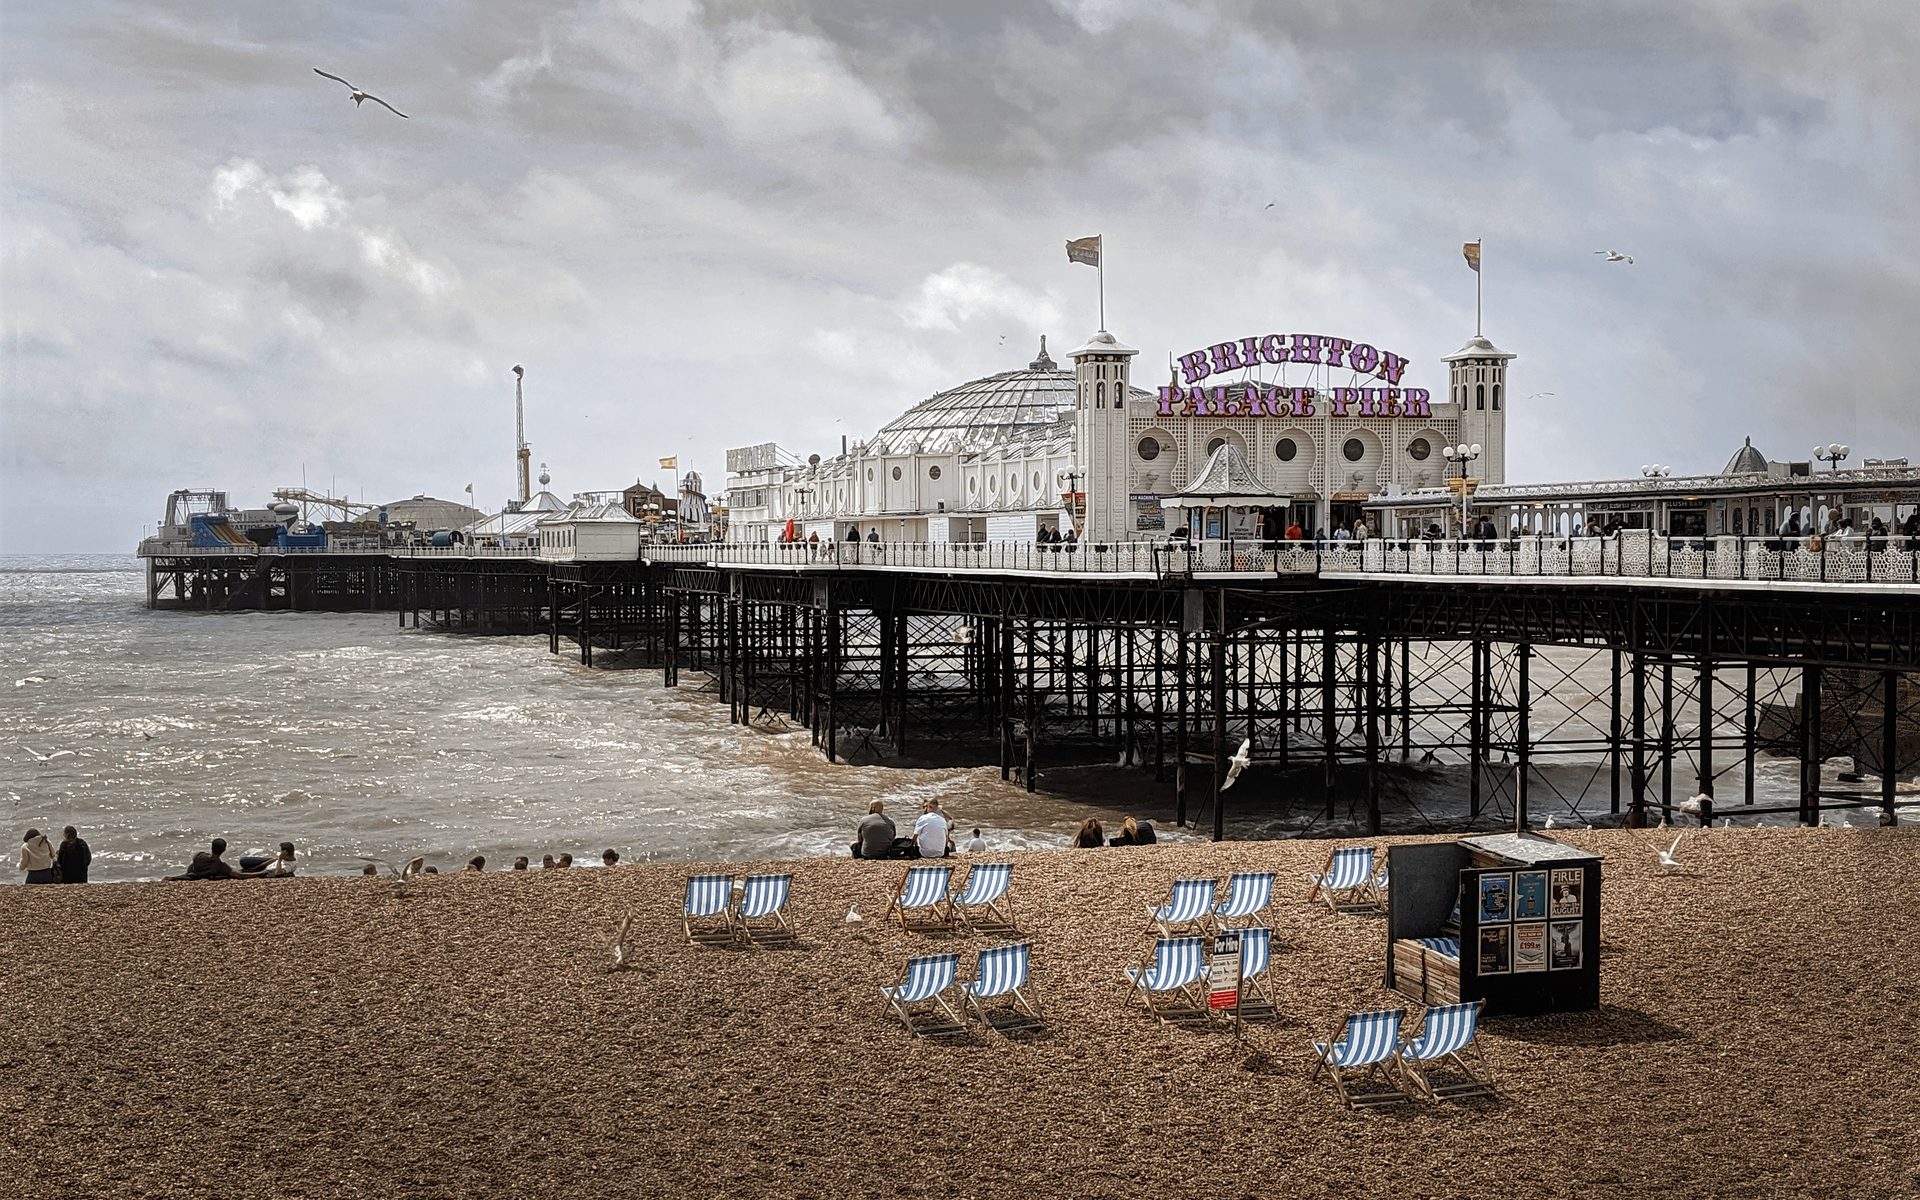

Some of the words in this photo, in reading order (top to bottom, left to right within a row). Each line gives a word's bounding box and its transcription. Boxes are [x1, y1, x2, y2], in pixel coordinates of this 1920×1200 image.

[1177, 334, 1409, 386] BRIGHTON
[1156, 386, 1317, 418] PALACE
[1331, 387, 1433, 419] PIER
[1552, 871, 1581, 882] FIRLE
[1214, 938, 1225, 952] For
[1225, 936, 1238, 952] Hire
